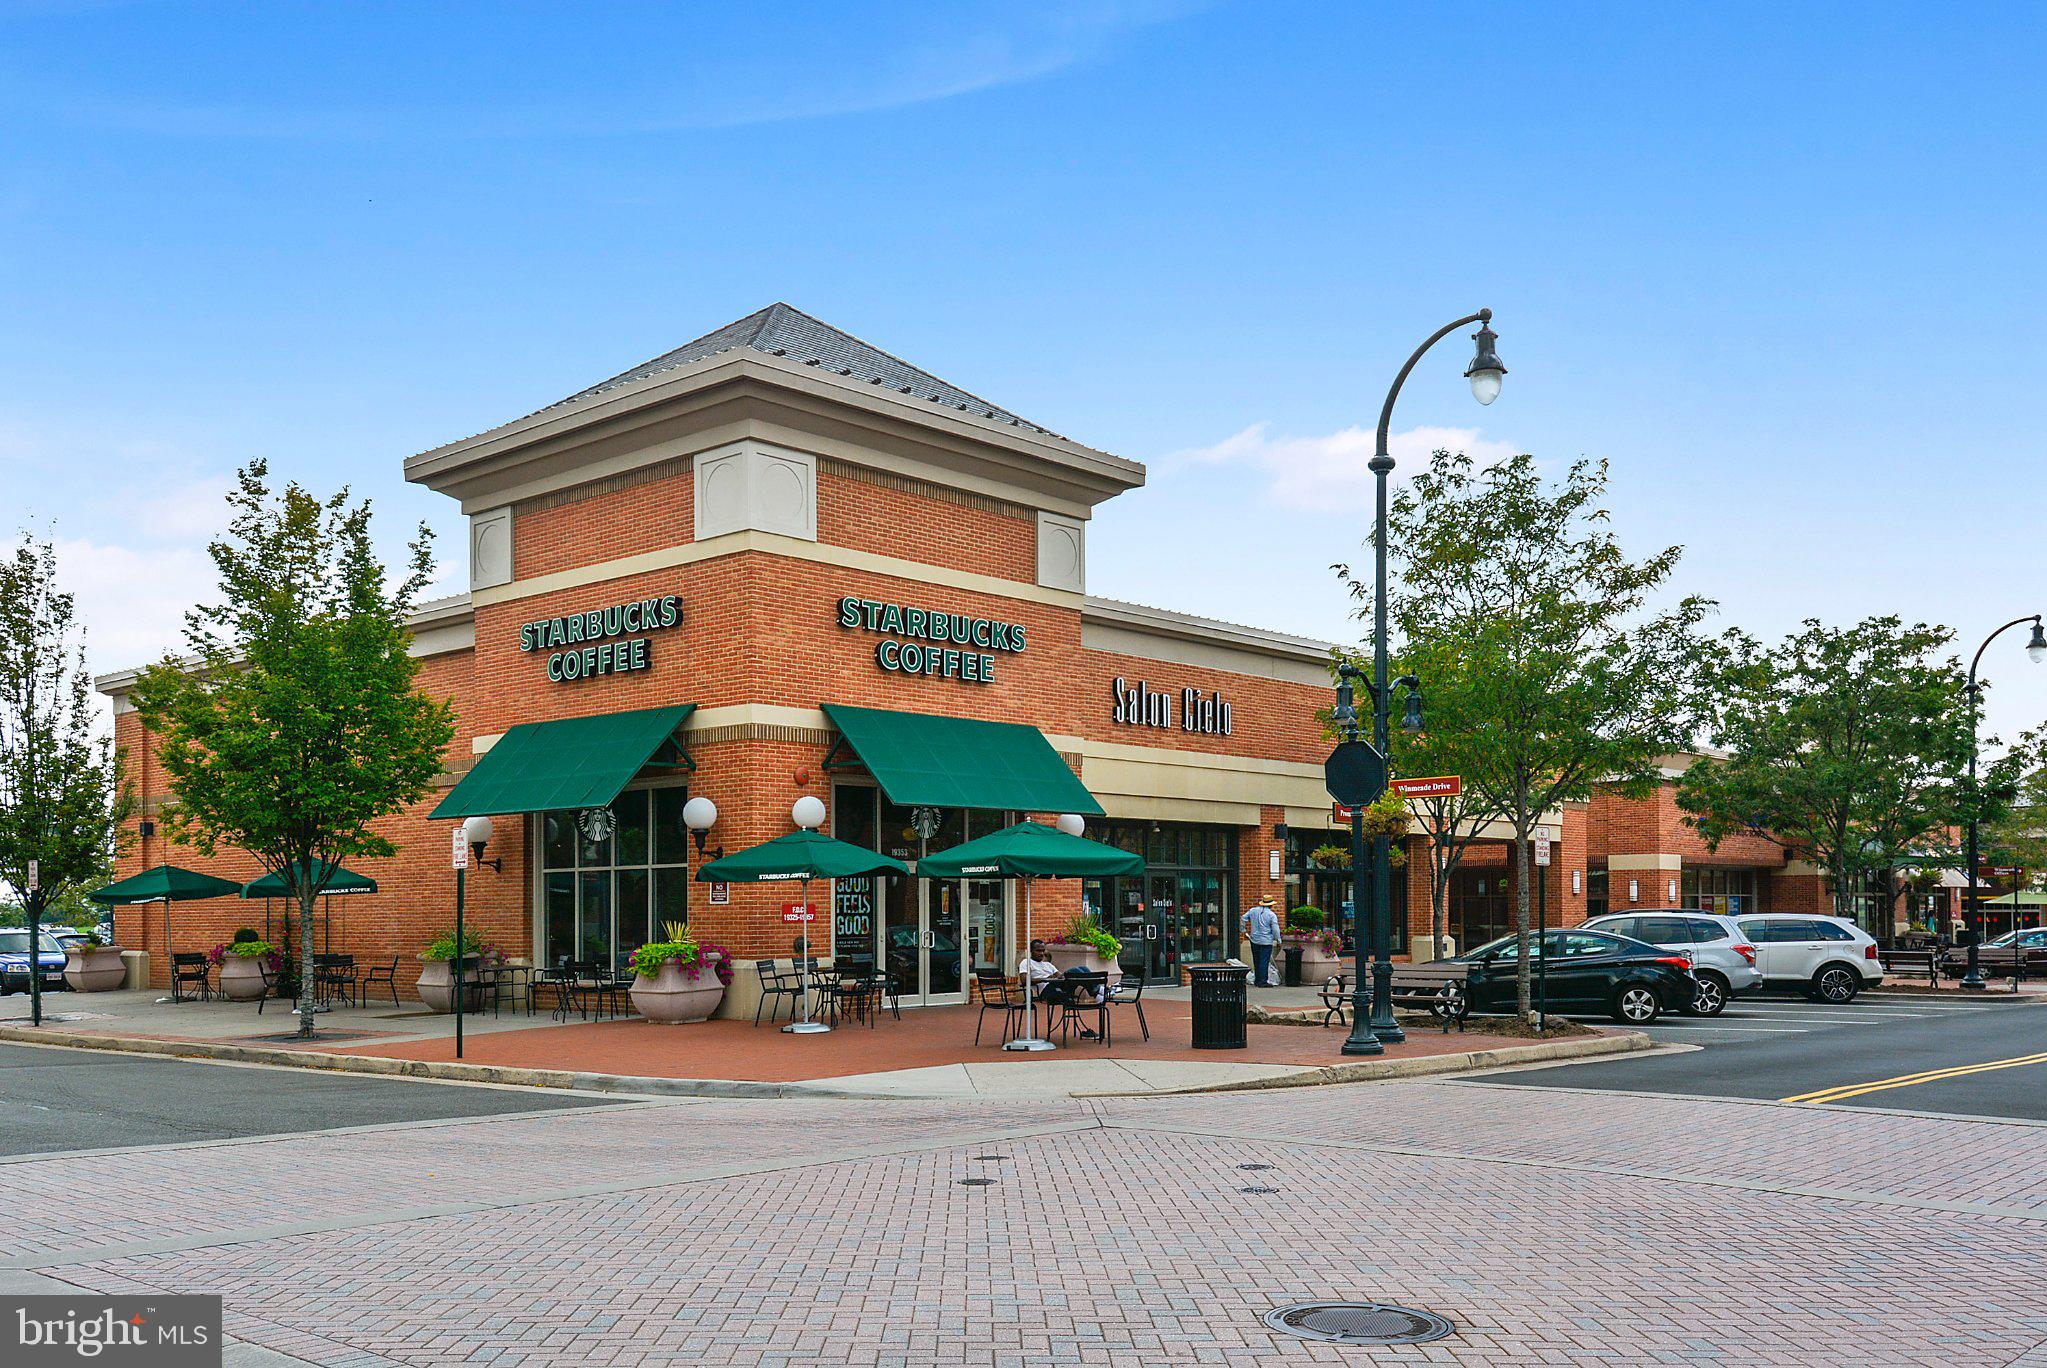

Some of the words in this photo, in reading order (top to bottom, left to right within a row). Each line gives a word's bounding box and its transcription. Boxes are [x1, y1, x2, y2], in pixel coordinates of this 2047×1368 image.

[520, 595, 680, 652] STARBUCKS
[839, 596, 1027, 653] STARBUCKS
[547, 638, 648, 682] COFFEE
[877, 640, 995, 683] COFFEE
[1113, 677, 1171, 729] Salon
[1182, 687, 1232, 736] Cielo
[1398, 784, 1432, 793] Winmeade
[1433, 783, 1451, 791] Drive
[836, 894, 871, 914] FEELS
[837, 877, 870, 893] GOOD
[837, 915, 870, 935] GOOD
